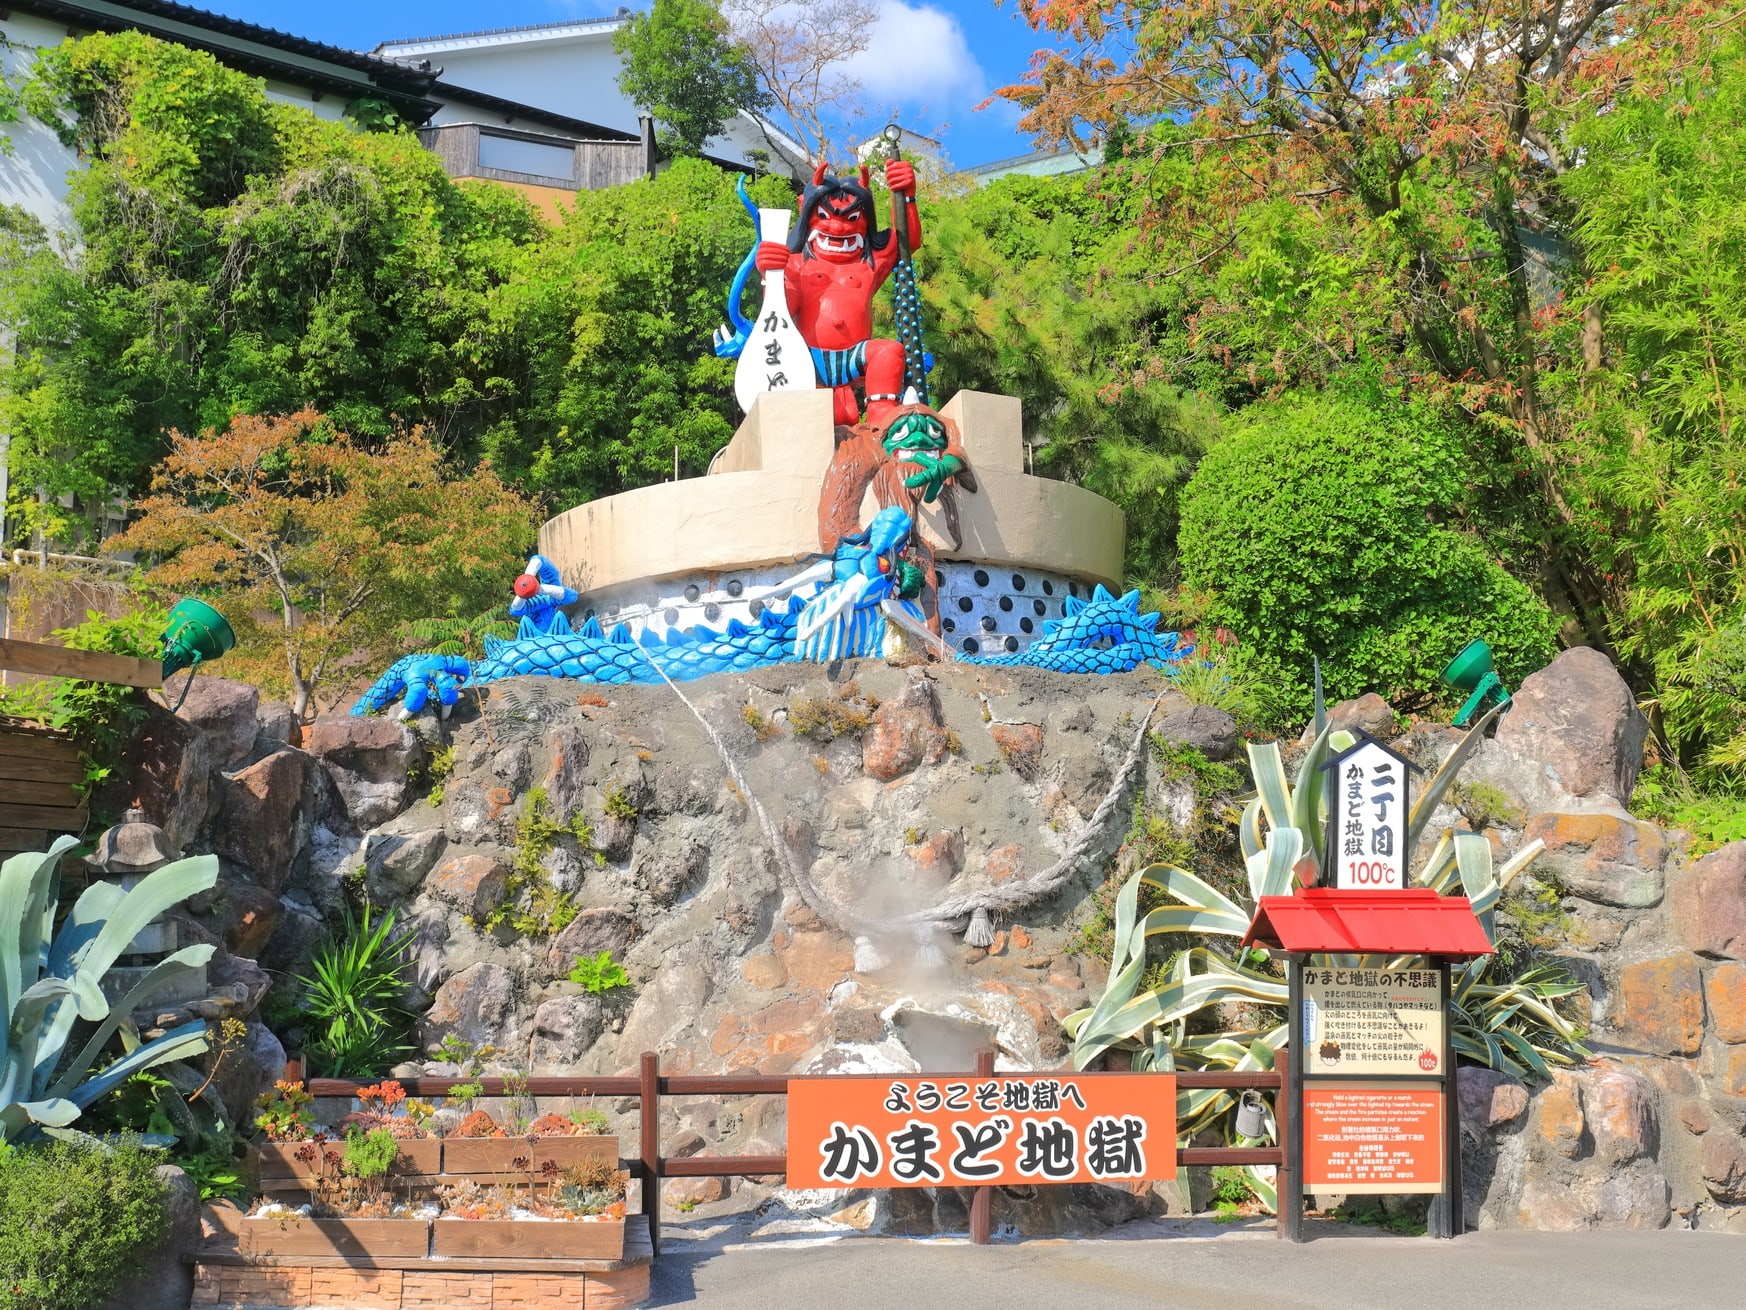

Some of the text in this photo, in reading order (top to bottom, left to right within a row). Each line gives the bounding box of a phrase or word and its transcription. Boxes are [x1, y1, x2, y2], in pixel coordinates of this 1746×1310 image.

[764, 310, 789, 391] かまど
[1344, 763, 1365, 857] かまど地獄
[1370, 762, 1396, 857] 二丁目
[1304, 970, 1437, 988] かまど地獄の不思議
[884, 1081, 1086, 1112] ようこそ地獄へ
[821, 1116, 1146, 1183] かまど地獄
